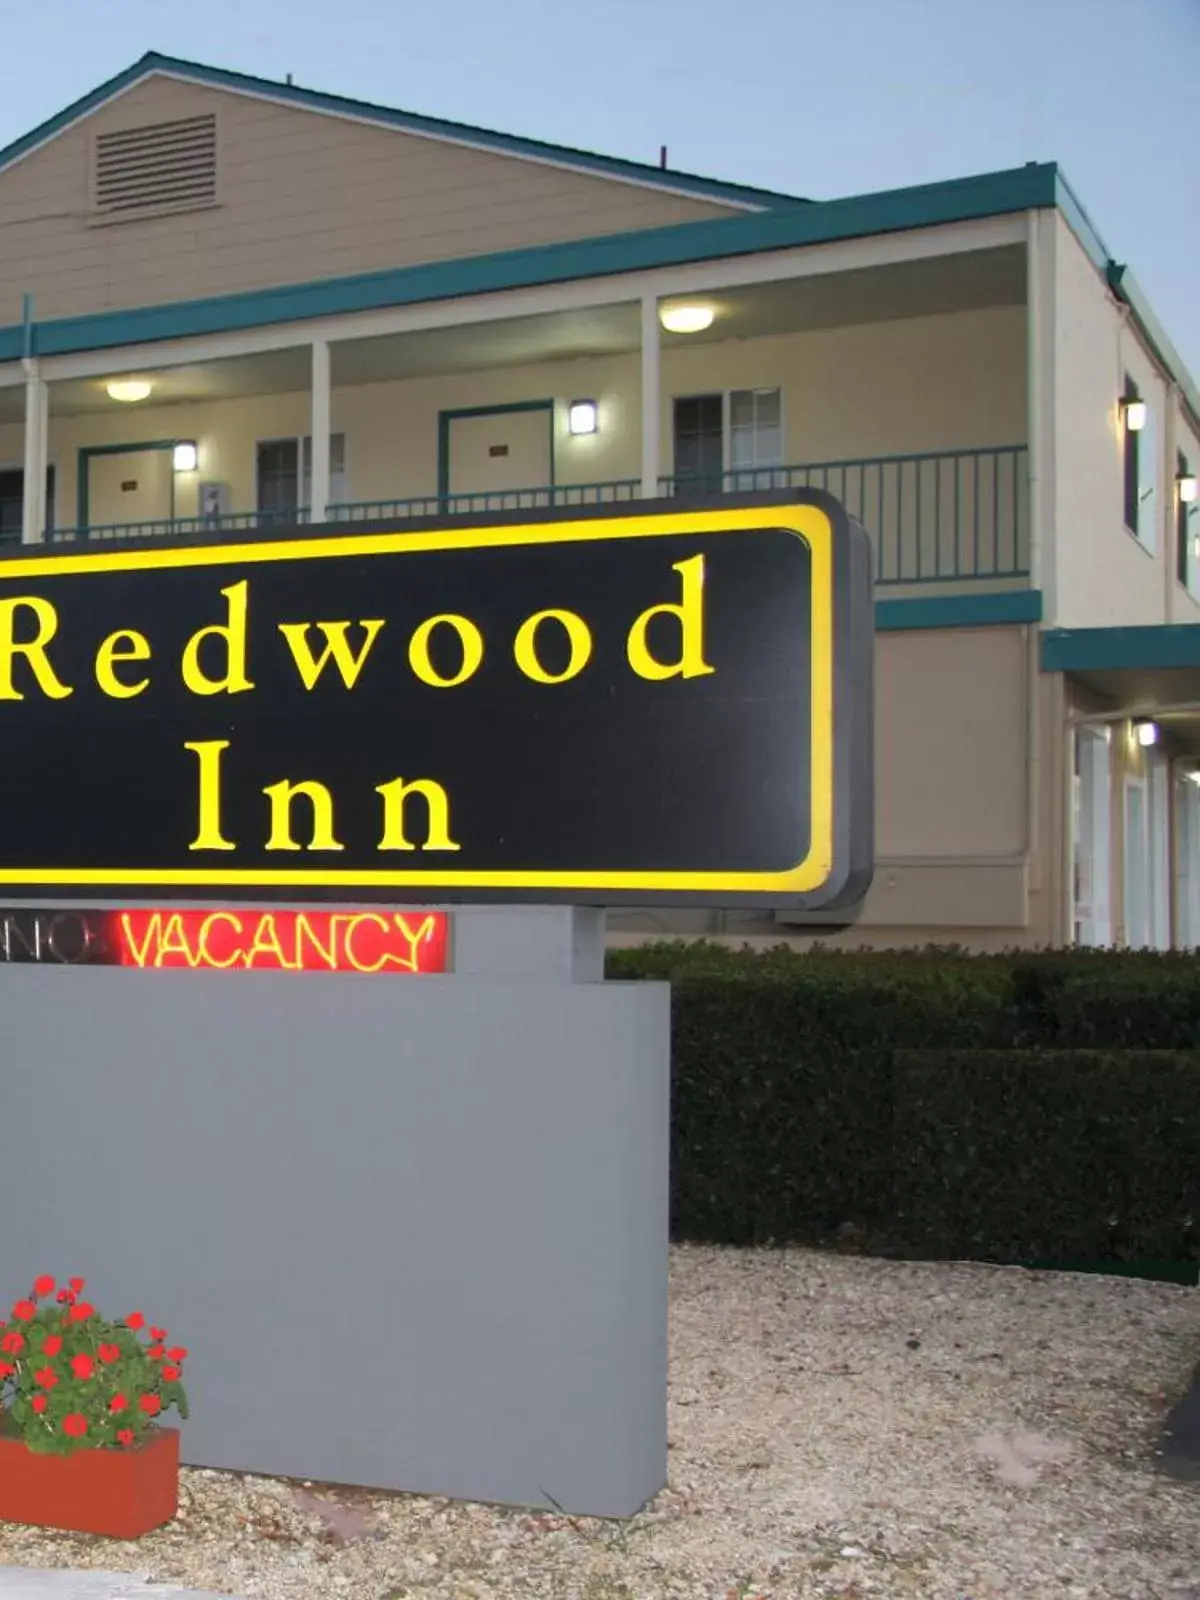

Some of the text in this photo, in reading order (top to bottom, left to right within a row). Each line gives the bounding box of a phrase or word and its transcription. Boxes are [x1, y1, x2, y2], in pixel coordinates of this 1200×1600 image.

[184, 740, 461, 851] Inn
[0, 911, 436, 973] NO VACANCY
